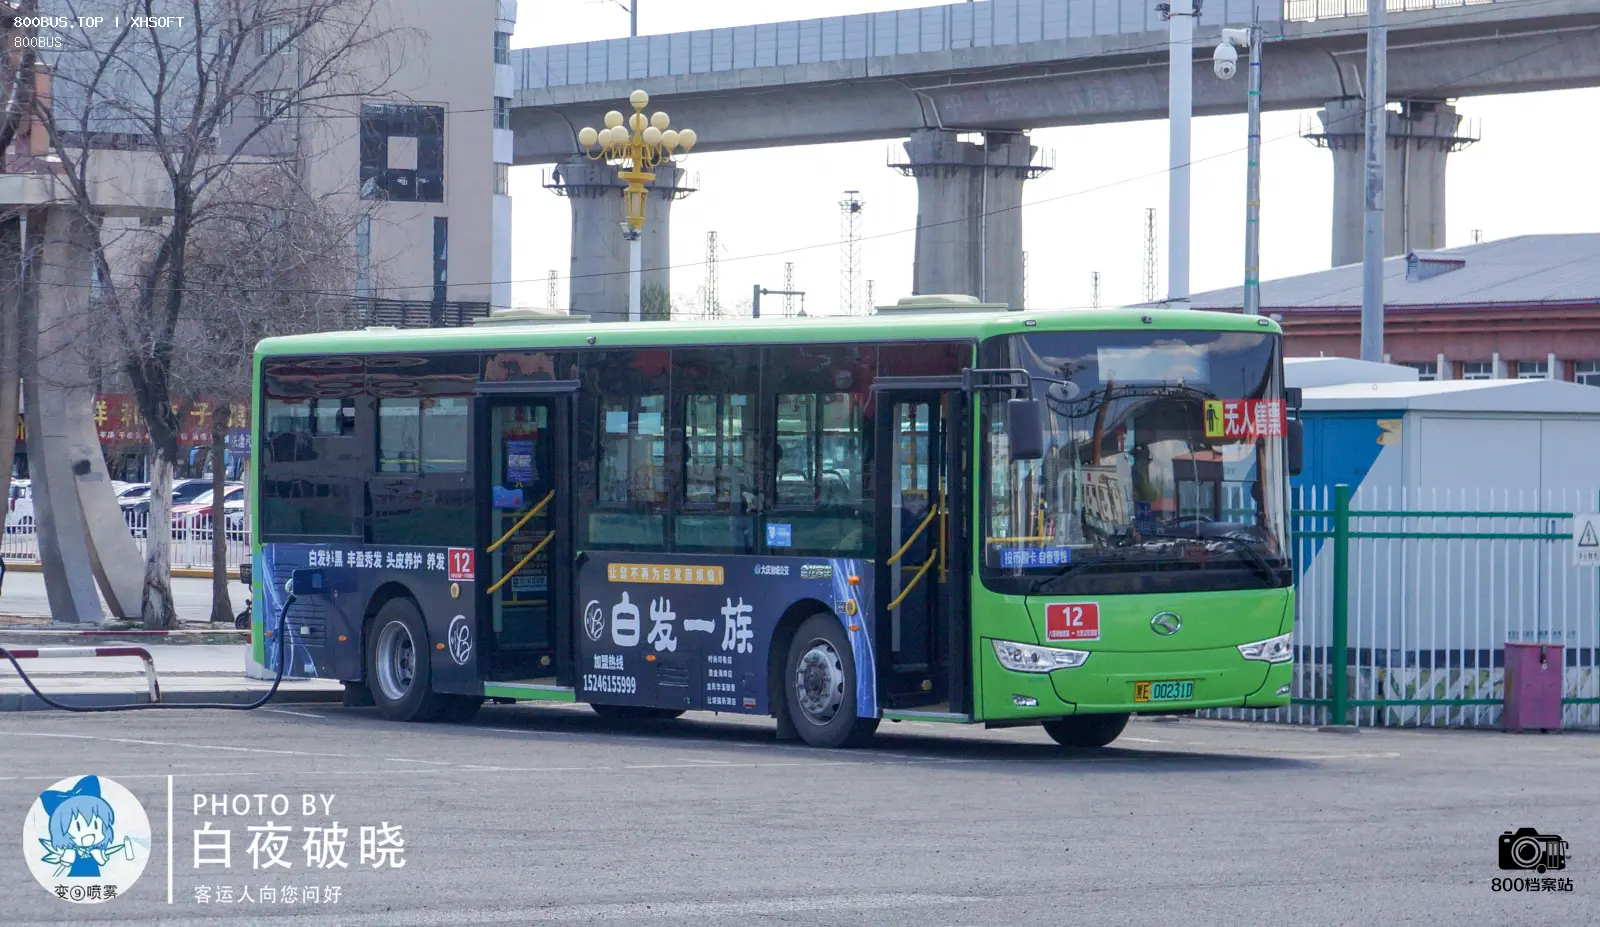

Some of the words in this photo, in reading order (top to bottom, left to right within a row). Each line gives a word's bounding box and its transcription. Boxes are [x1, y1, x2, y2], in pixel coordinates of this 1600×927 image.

[1224, 401, 1281, 435] 无人售票
[347, 550, 383, 569] 丰盈秀发
[386, 551, 422, 569] 头皮养护
[427, 552, 445, 571] 养发
[454, 552, 470, 572] 12
[611, 590, 754, 654] 白发一族
[1062, 606, 1084, 627] 12
[593, 653, 624, 671] 加盟热线
[583, 674, 637, 694] 15246155999
